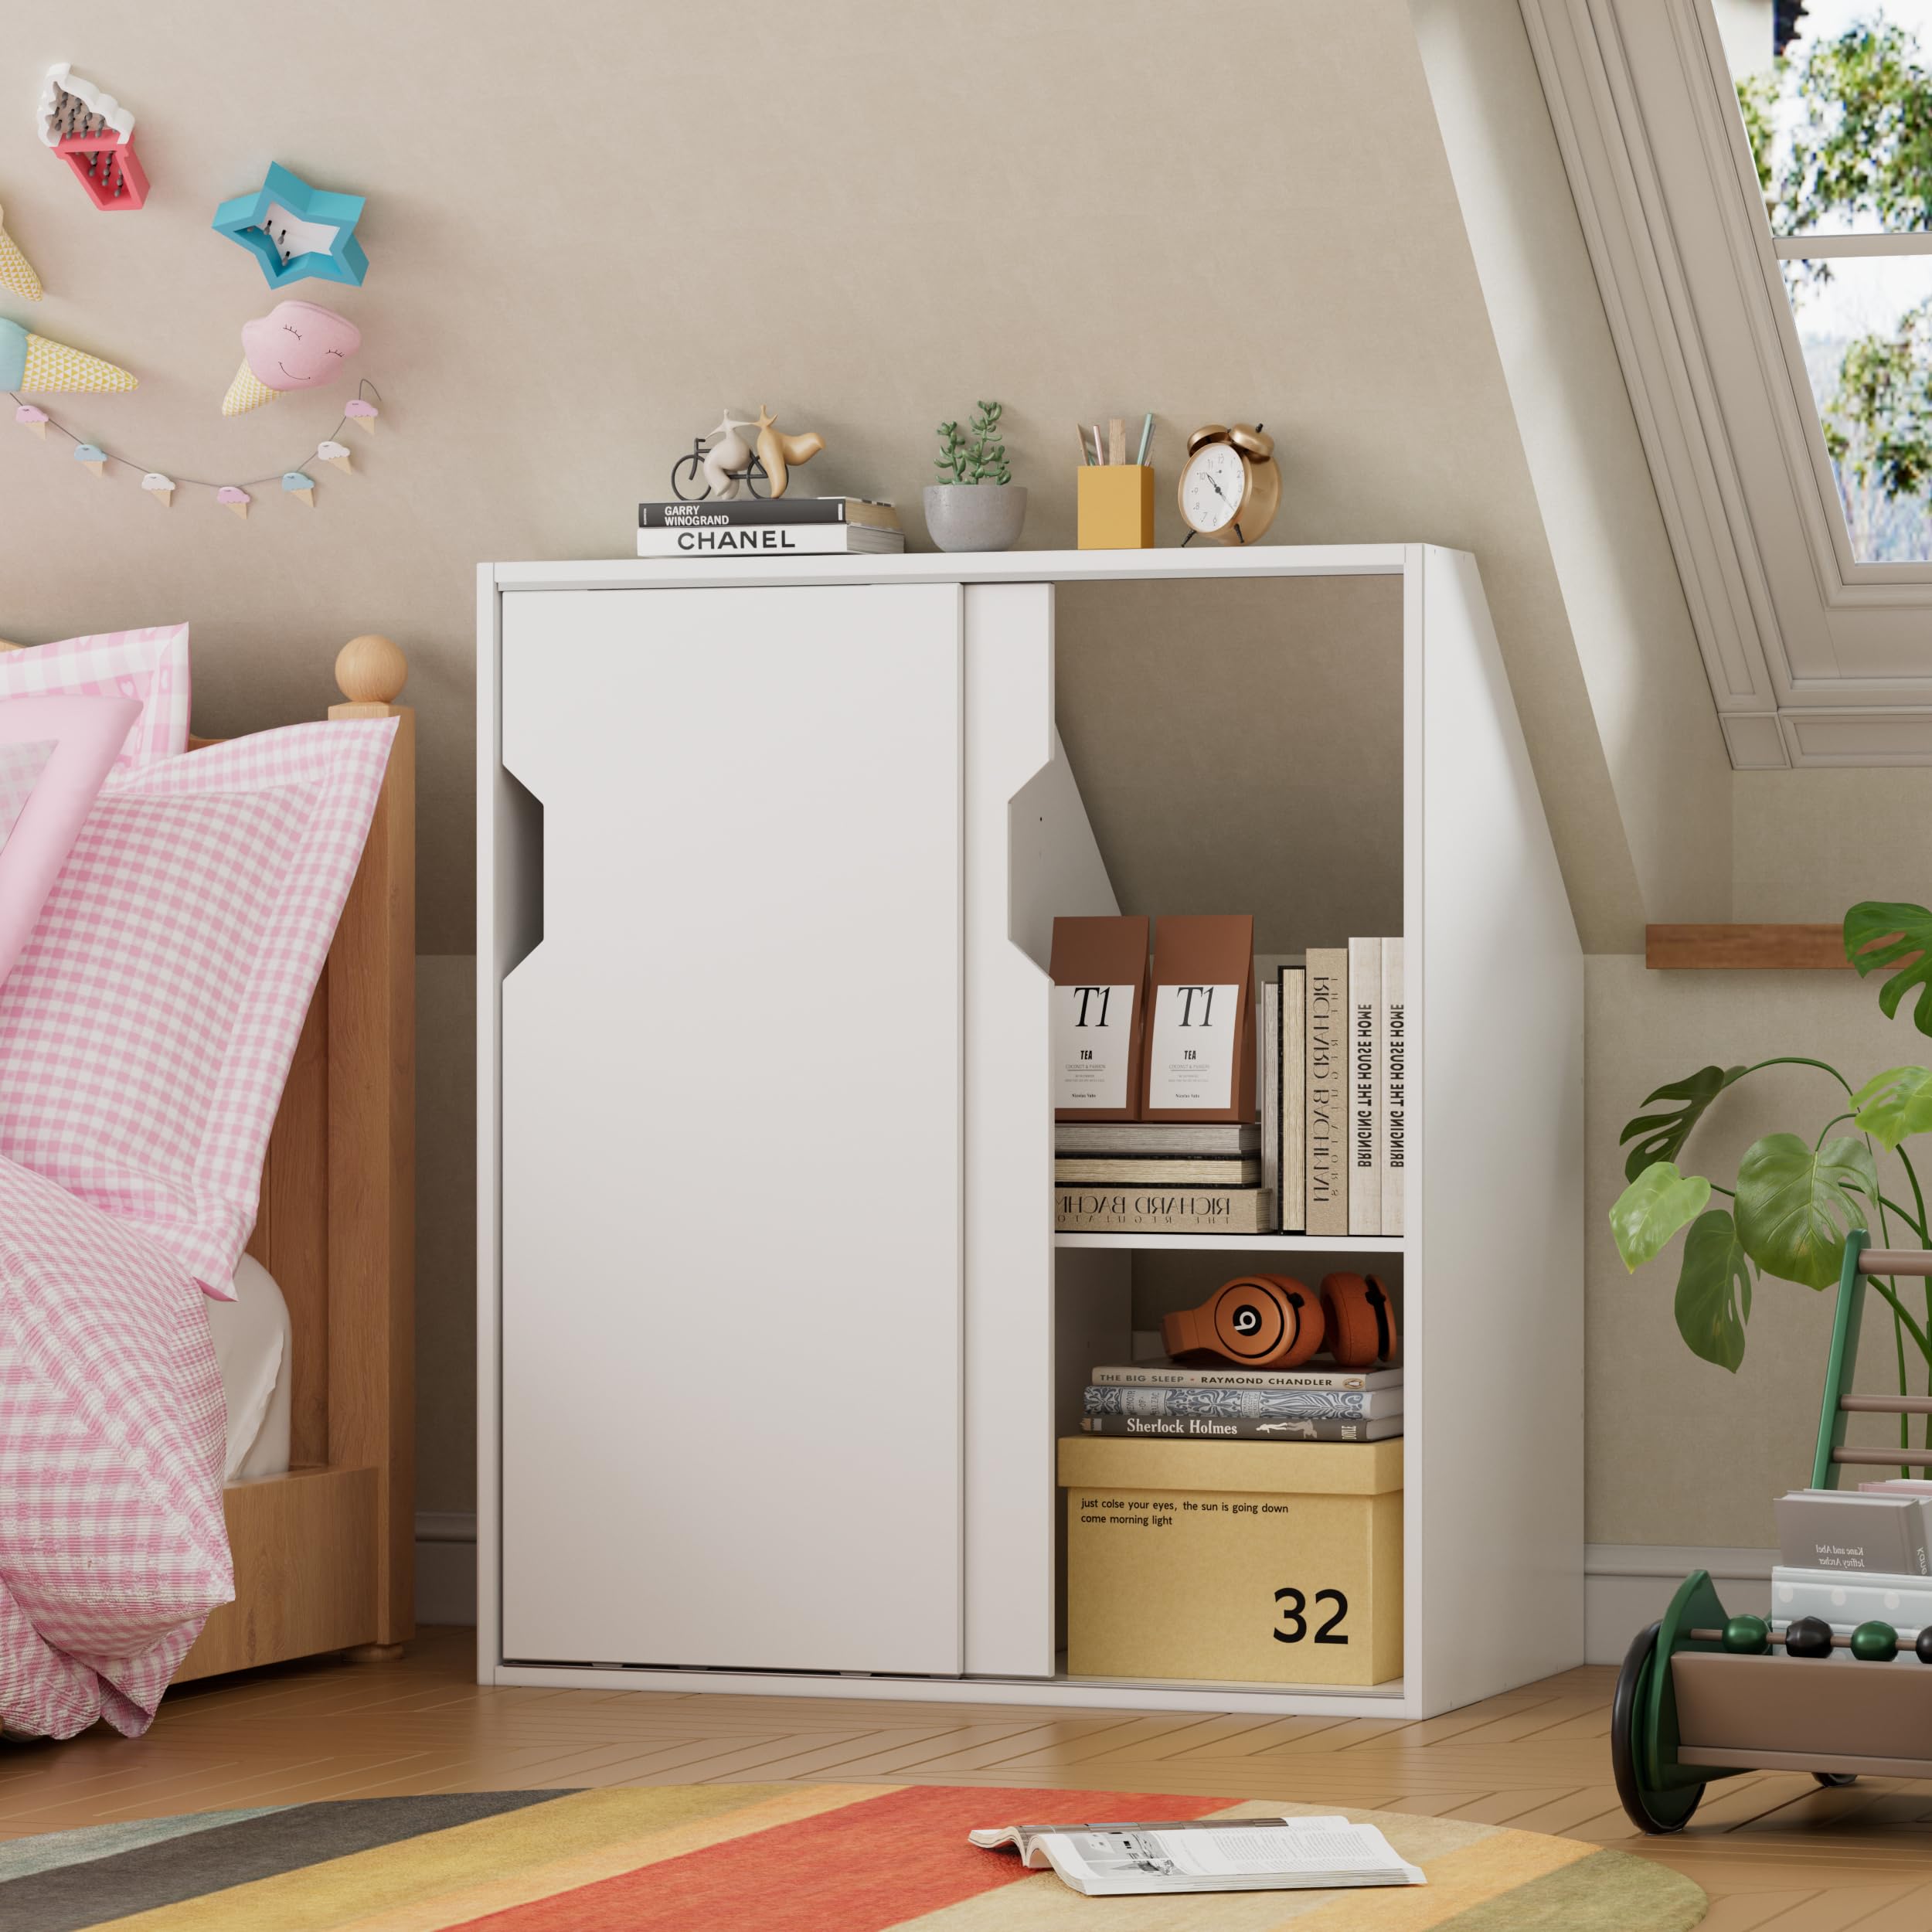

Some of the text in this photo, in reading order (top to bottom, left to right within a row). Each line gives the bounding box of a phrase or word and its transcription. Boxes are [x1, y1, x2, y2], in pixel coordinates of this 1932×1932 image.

[665, 505, 699, 516] GARRY
[665, 515, 729, 526] WINOGRAND
[678, 529, 795, 551] CHANEL
[1073, 986, 1111, 1027] T1
[1177, 986, 1214, 1027] T1
[1080, 1050, 1093, 1060] TEA
[1184, 1050, 1196, 1060] TEA
[1201, 1376, 1263, 1385] RAYMOND
[1268, 1378, 1332, 1386] CHANDLER
[1127, 1418, 1238, 1435] Sherlock Holmes
[1081, 1498, 1098, 1510] just
[1101, 1499, 1124, 1509] colse
[1128, 1502, 1149, 1511] your
[1153, 1502, 1178, 1512] eyes,
[1183, 1501, 1198, 1511] the
[1222, 1502, 1229, 1512] is
[1233, 1502, 1258, 1514] going
[1262, 1503, 1288, 1513] down
[1110, 1515, 1149, 1526] morning
[1152, 1515, 1172, 1526] light
[1273, 1587, 1349, 1645] 32
